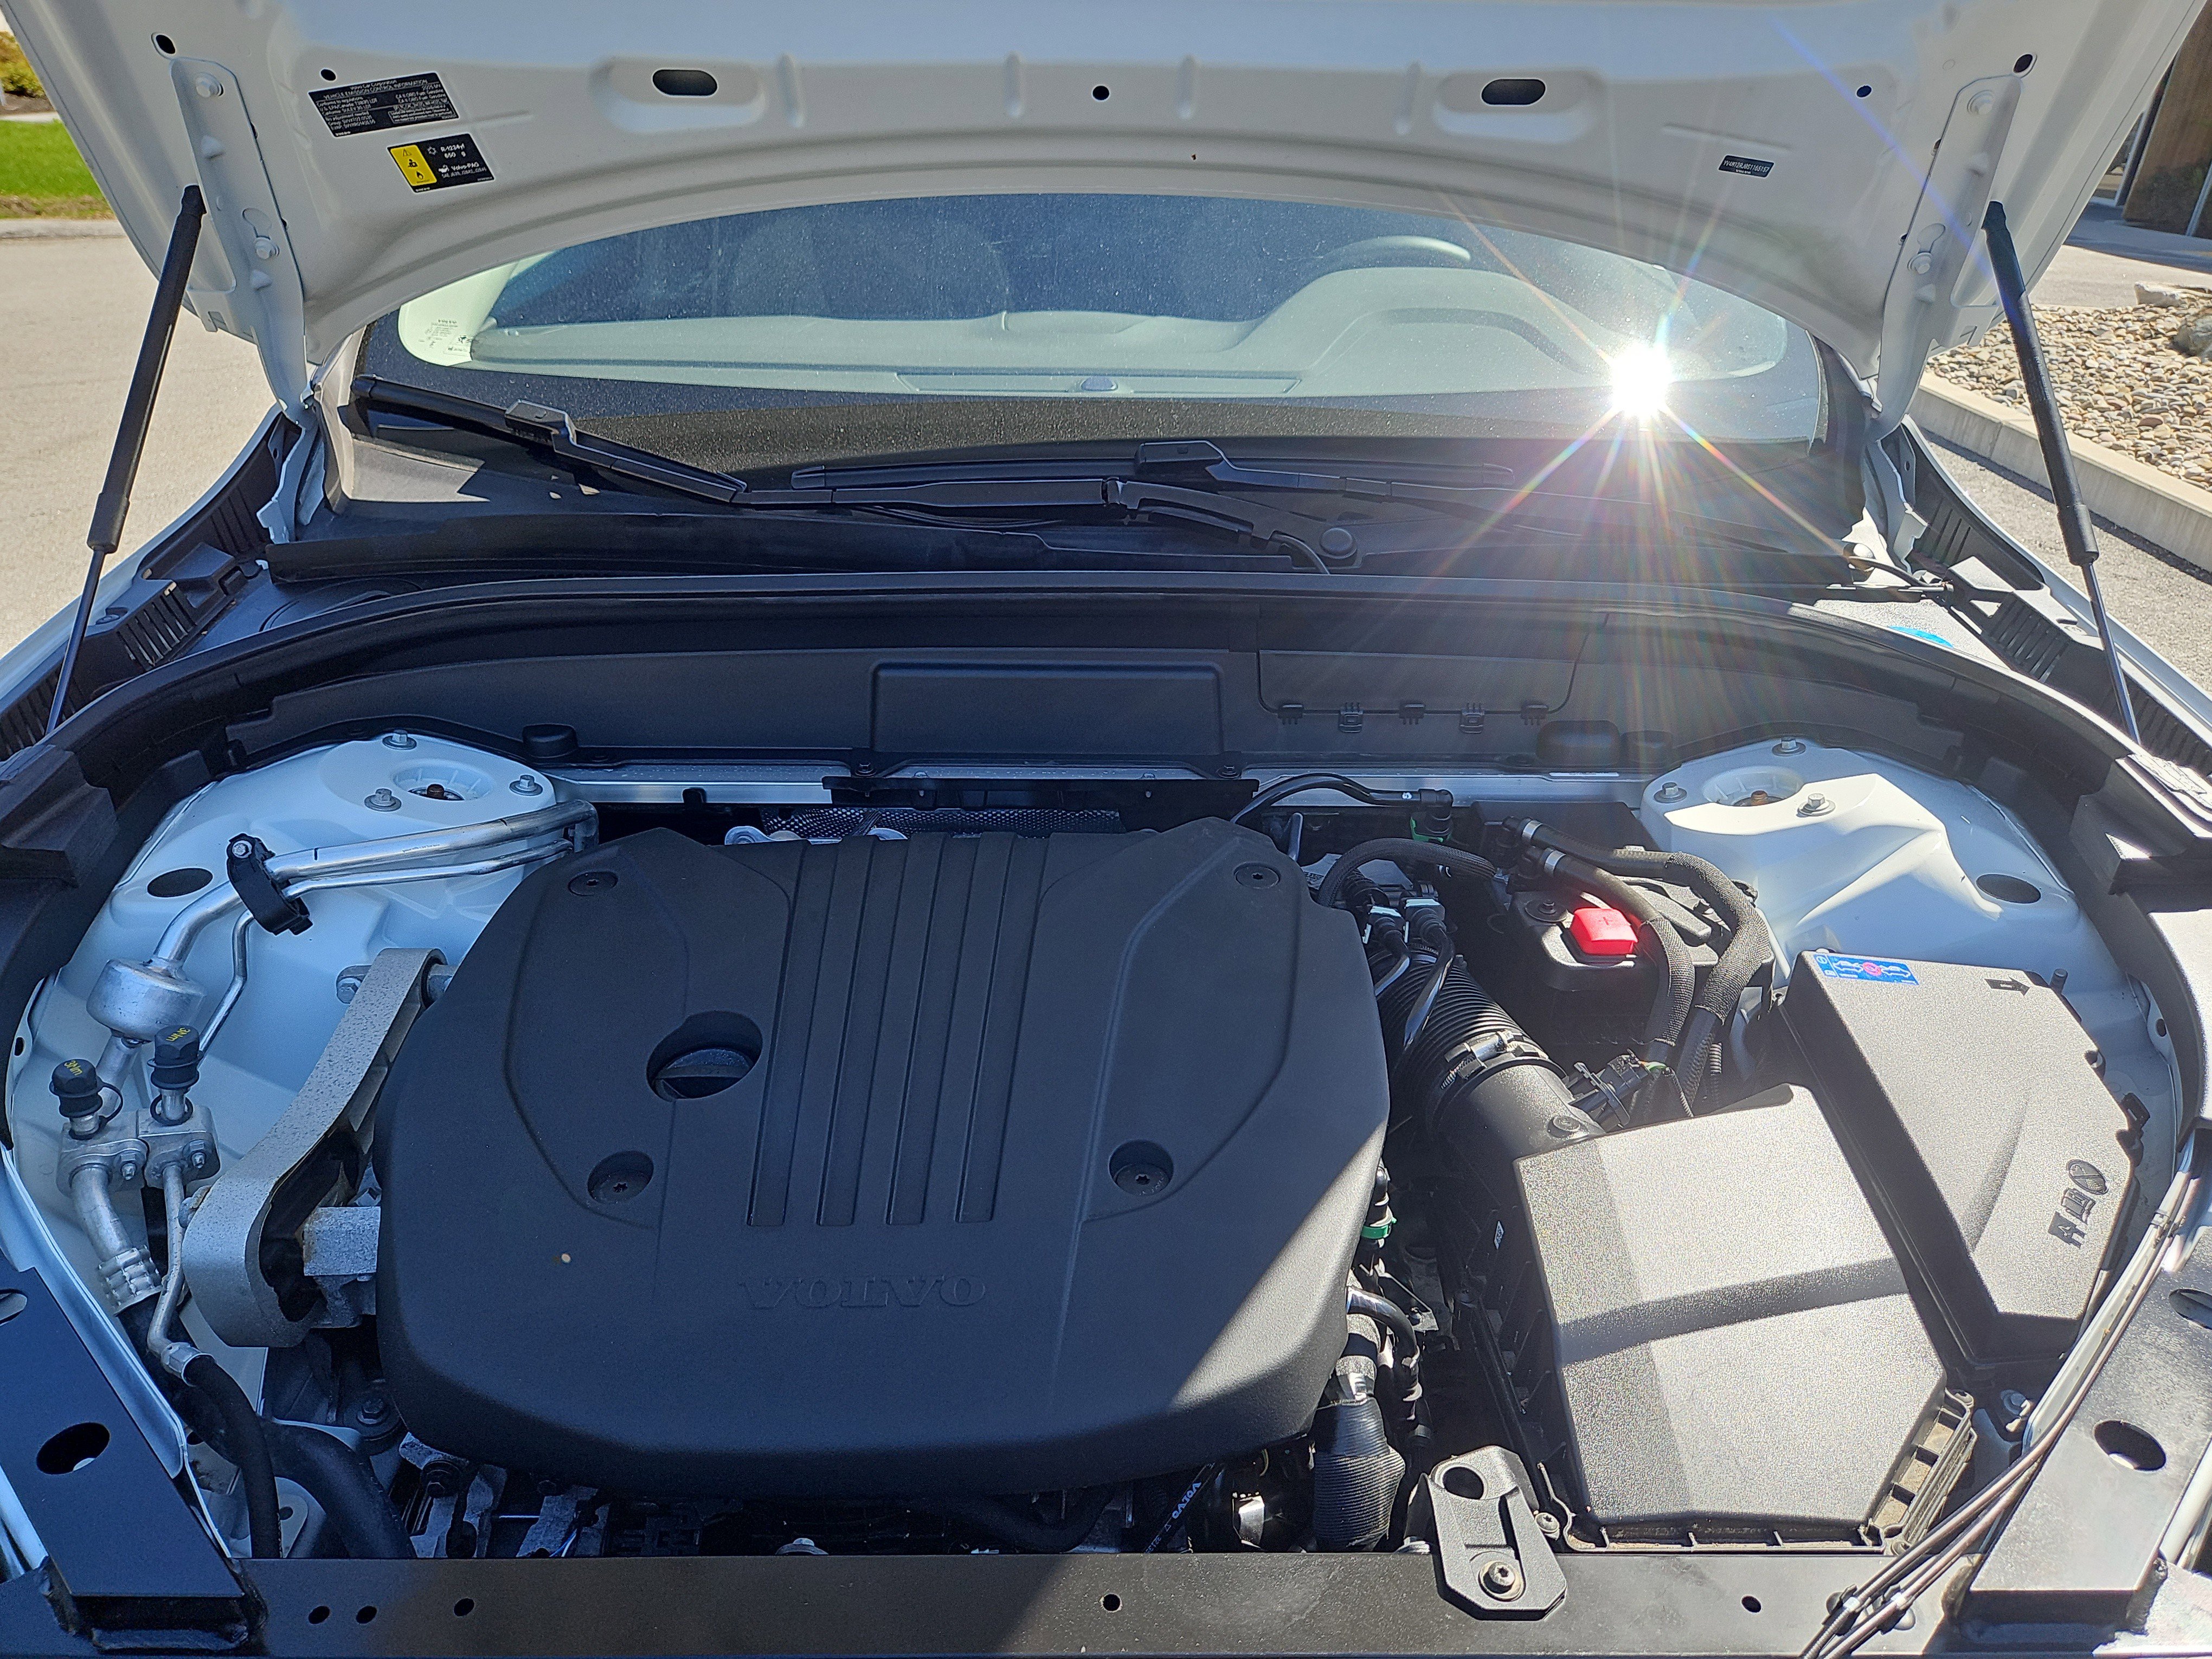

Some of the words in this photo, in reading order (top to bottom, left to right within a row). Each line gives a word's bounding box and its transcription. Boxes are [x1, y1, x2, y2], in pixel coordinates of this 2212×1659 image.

[166, 1027, 190, 1041] 3Nm
[64, 1060, 82, 1076] 3Nm
[738, 1274, 987, 1309] VOLVO
[1172, 1482, 1201, 1519] VOLVO
